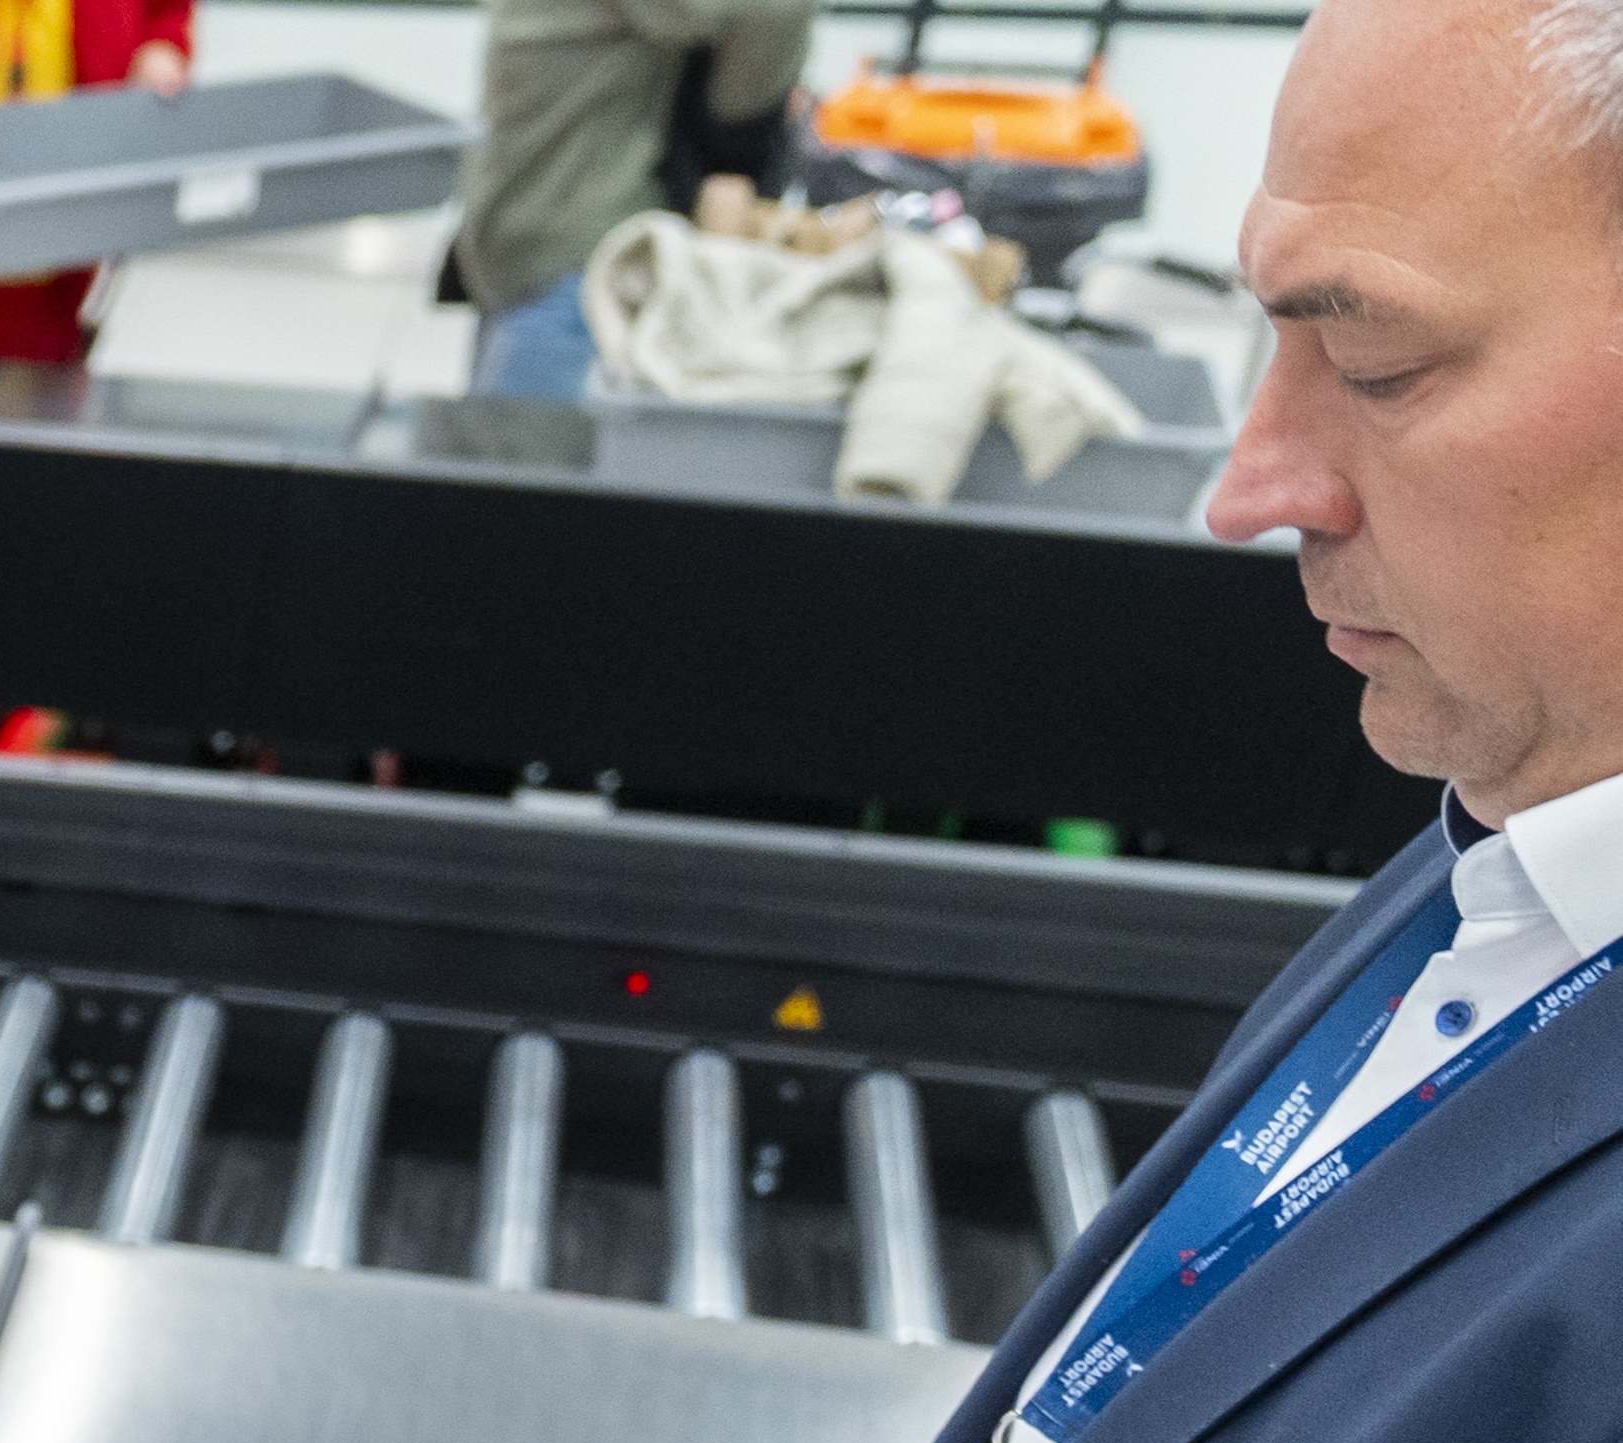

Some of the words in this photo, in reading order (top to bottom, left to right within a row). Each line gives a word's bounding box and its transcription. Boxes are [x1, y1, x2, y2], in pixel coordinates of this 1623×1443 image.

[1535, 955, 1612, 1017] AIRPORT
[1239, 1080, 1312, 1166] BUDAPEST
[1256, 1103, 1315, 1175] AIRPORT
[1273, 1162, 1350, 1229] BUDAPEST
[1279, 1150, 1343, 1206] AIRPORT
[1058, 1332, 1115, 1389] AIRPORT
[1061, 1344, 1130, 1408] BUDAPEST
